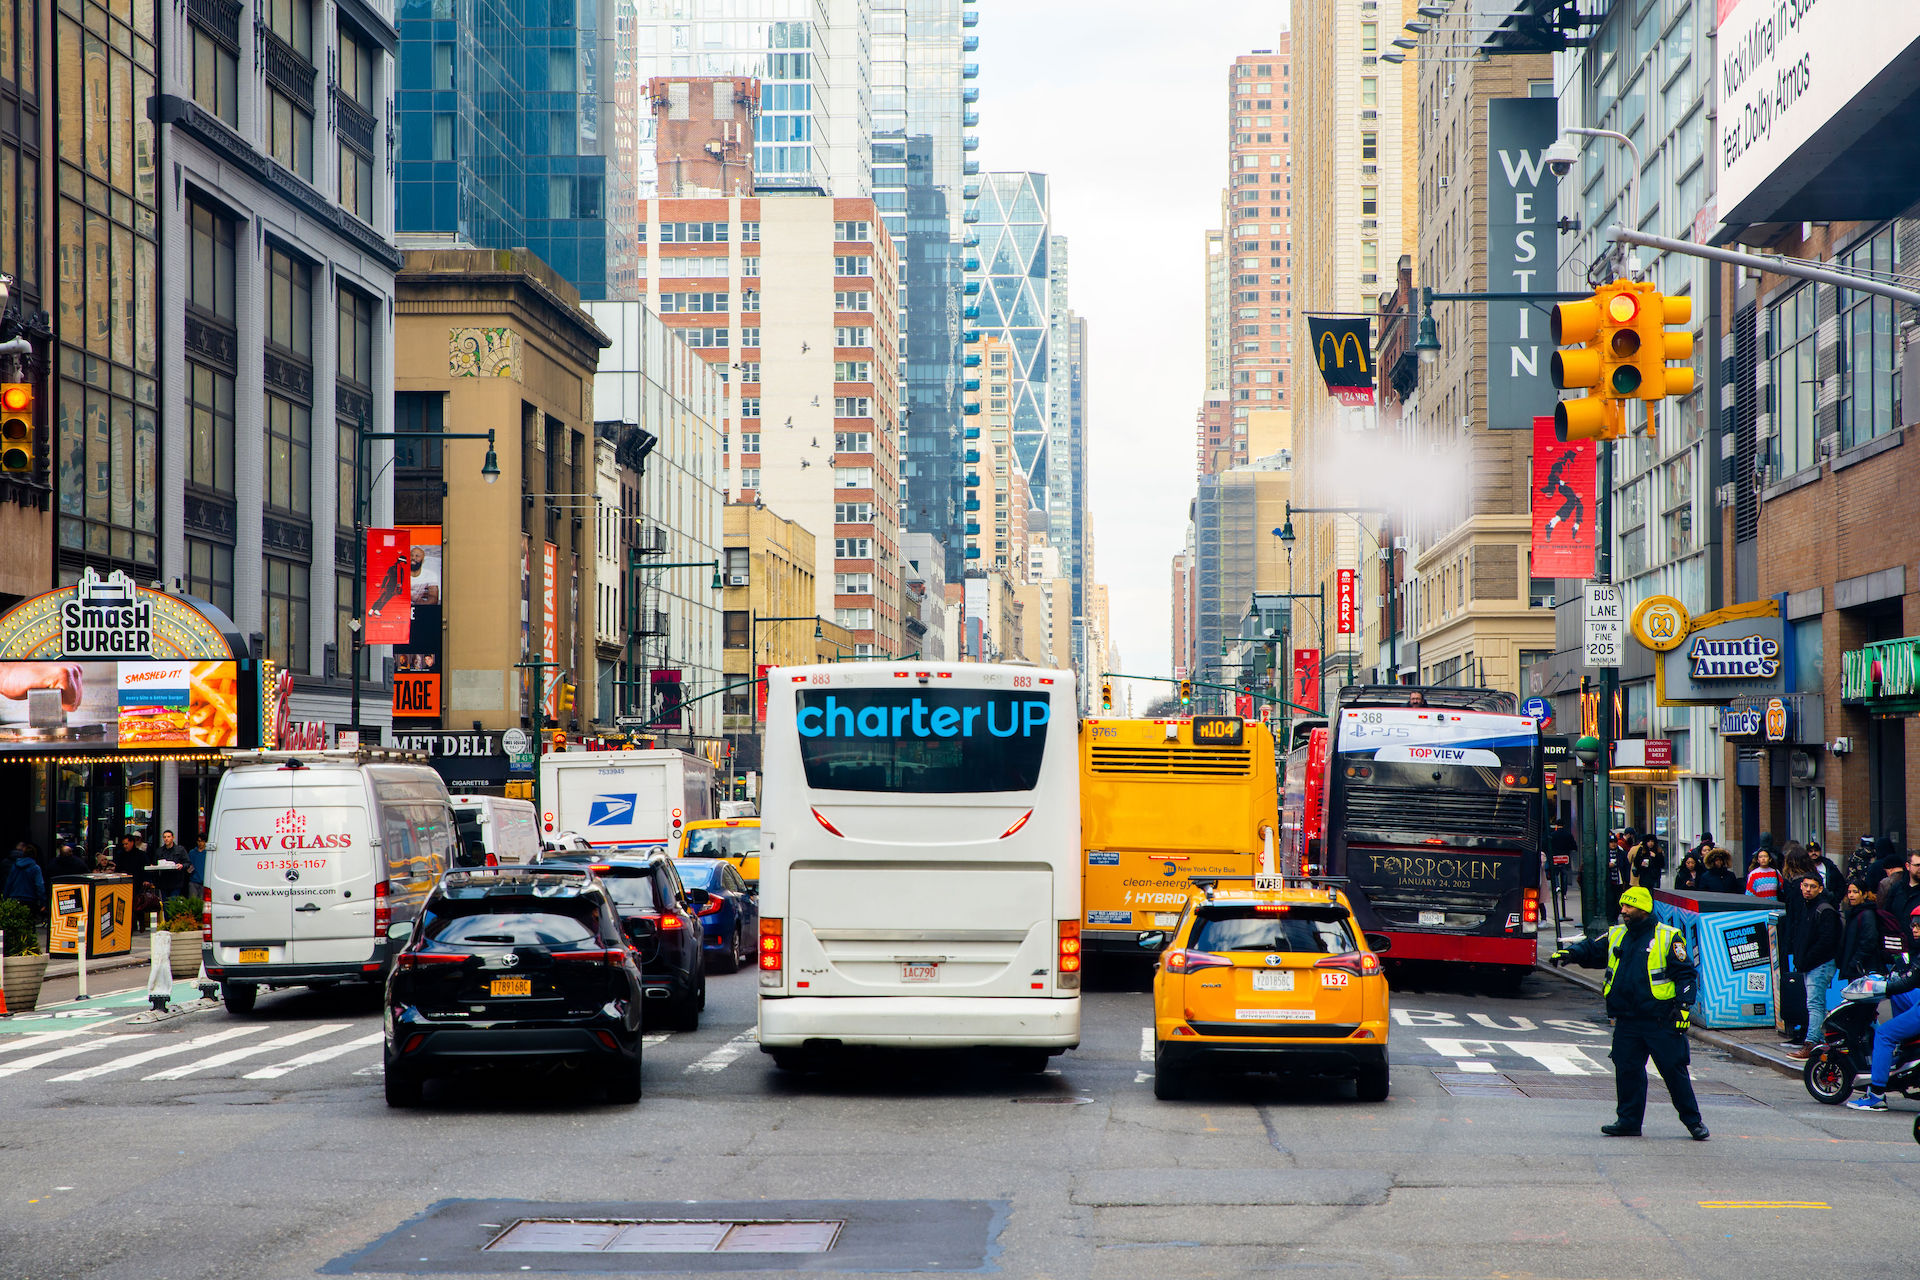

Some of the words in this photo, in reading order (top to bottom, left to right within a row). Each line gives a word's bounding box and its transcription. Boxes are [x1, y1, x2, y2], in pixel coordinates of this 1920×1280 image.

[1723, 35, 1747, 104] Nicki
[1748, 3, 1776, 76] Minaj
[1777, 0, 1787, 44] in
[1723, 117, 1744, 172] feat.
[1744, 88, 1773, 150] Dolby
[1774, 51, 1811, 121] Atmos
[1498, 148, 1548, 378] WESTIN
[1344, 391, 1354, 401] 24
[1594, 589, 1615, 601] BUS
[1341, 584, 1351, 621] PARK
[1590, 605, 1618, 617] LANE
[1590, 623, 1608, 632] TOW
[1610, 623, 1617, 632] &
[66, 630, 150, 652] BURGER
[1595, 633, 1613, 641] FINE
[1692, 635, 1777, 656] Auntie
[1694, 656, 1775, 677] Anne's
[124, 670, 167, 684] SMASHED
[168, 668, 183, 679] IT!
[812, 673, 831, 685] 883
[1013, 676, 1032, 688] 883
[1361, 712, 1383, 724] 368
[1091, 727, 1117, 738] 9765
[1200, 720, 1235, 738] M104
[1370, 725, 1410, 738] PS5
[442, 735, 493, 756] DELI
[1543, 746, 1567, 754] NDRY
[521, 754, 528, 762] 43
[1408, 747, 1465, 760] TOPVIEW
[234, 835, 273, 851] KW
[280, 833, 352, 850] GLASS
[256, 859, 327, 870] 631-356-1167
[1369, 855, 1502, 880] FORSPOKEN
[1122, 877, 1193, 889] clean-energy
[1257, 878, 1280, 889] 7V38
[1399, 876, 1438, 887] JANUARY
[1452, 879, 1471, 888] 2023
[246, 888, 336, 898] www.kwglassinc.com
[1135, 892, 1187, 905] HYBRID
[1725, 926, 1757, 938] EXPLORE
[1727, 936, 1748, 947] MORE
[1729, 945, 1739, 955] IN
[1738, 942, 1760, 953] TIMES
[1731, 951, 1760, 963] SQUARE
[493, 980, 528, 992] T789168C
[1390, 1007, 1610, 1036] BUS
